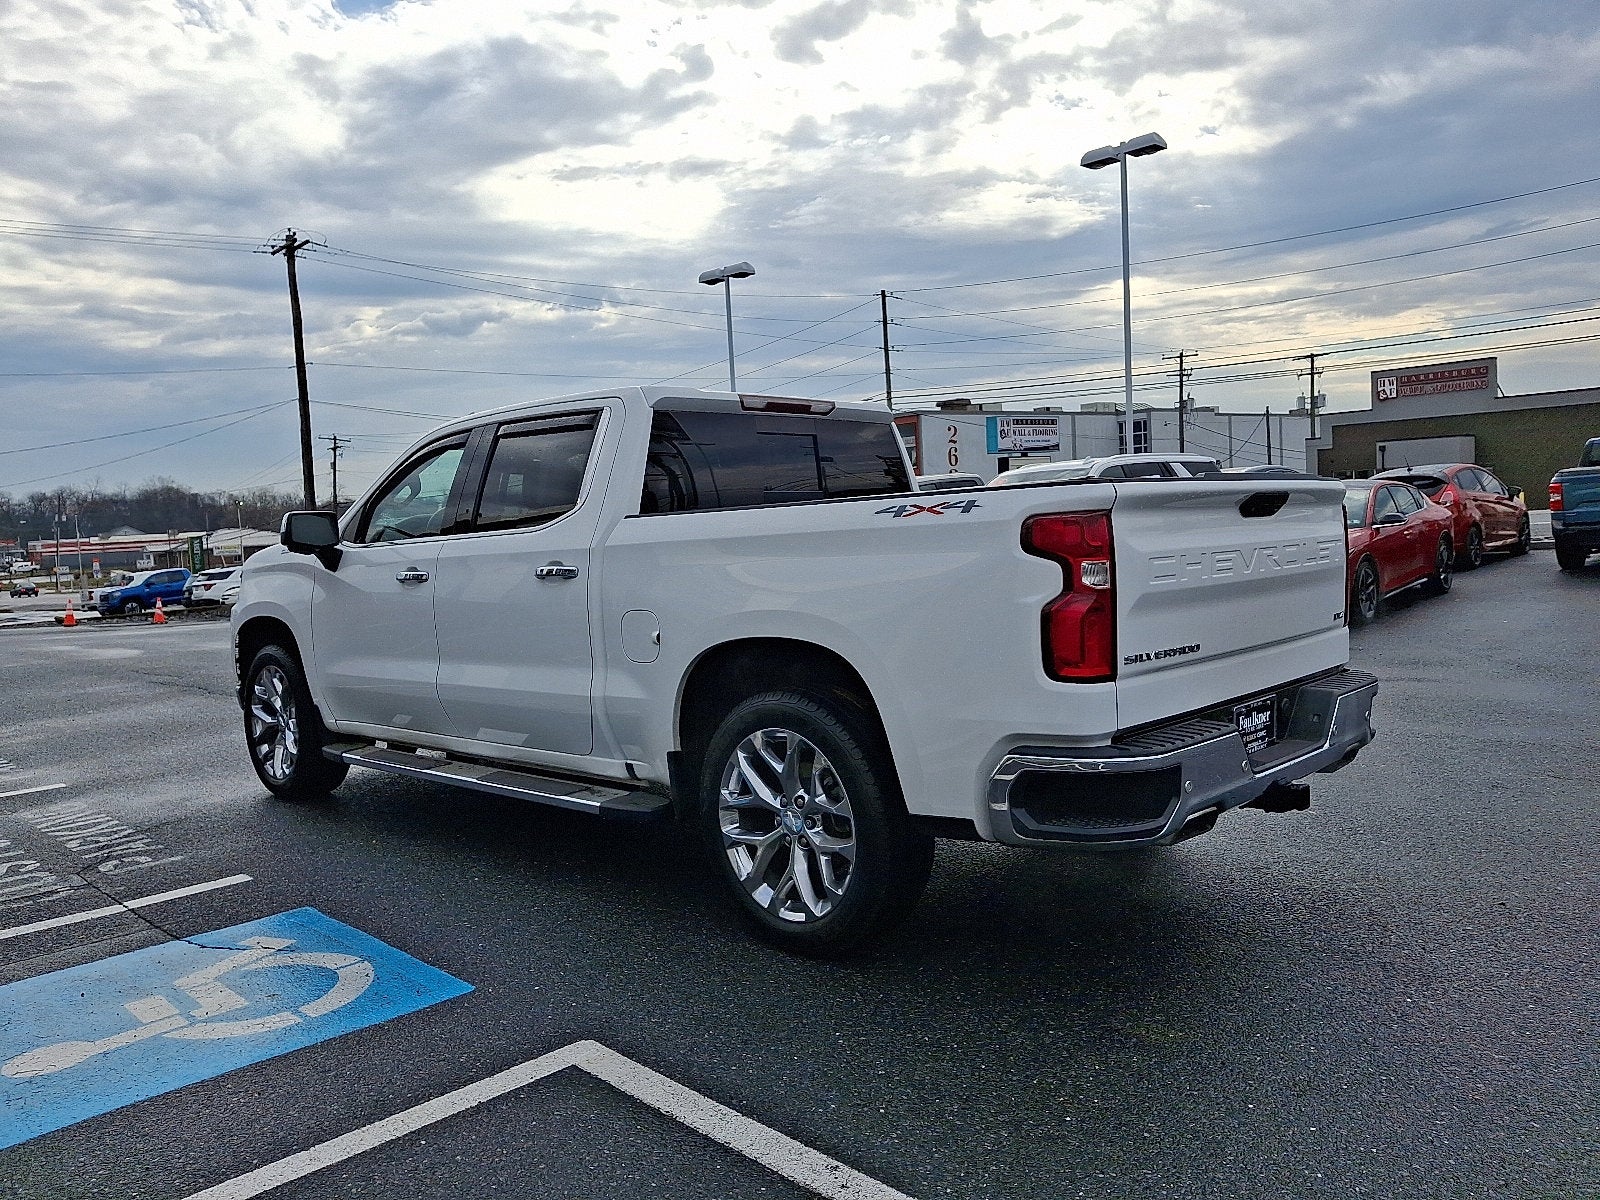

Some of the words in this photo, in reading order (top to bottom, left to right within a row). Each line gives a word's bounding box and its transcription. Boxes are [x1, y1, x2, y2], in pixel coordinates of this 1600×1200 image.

[1402, 369, 1487, 382] HARRISBURG
[1434, 378, 1488, 393] FLOORING
[947, 425, 958, 474] 26
[1148, 539, 1343, 584] CHEVROLET
[1123, 643, 1201, 665] SILVERADO
[1239, 711, 1270, 730] Faulkner
